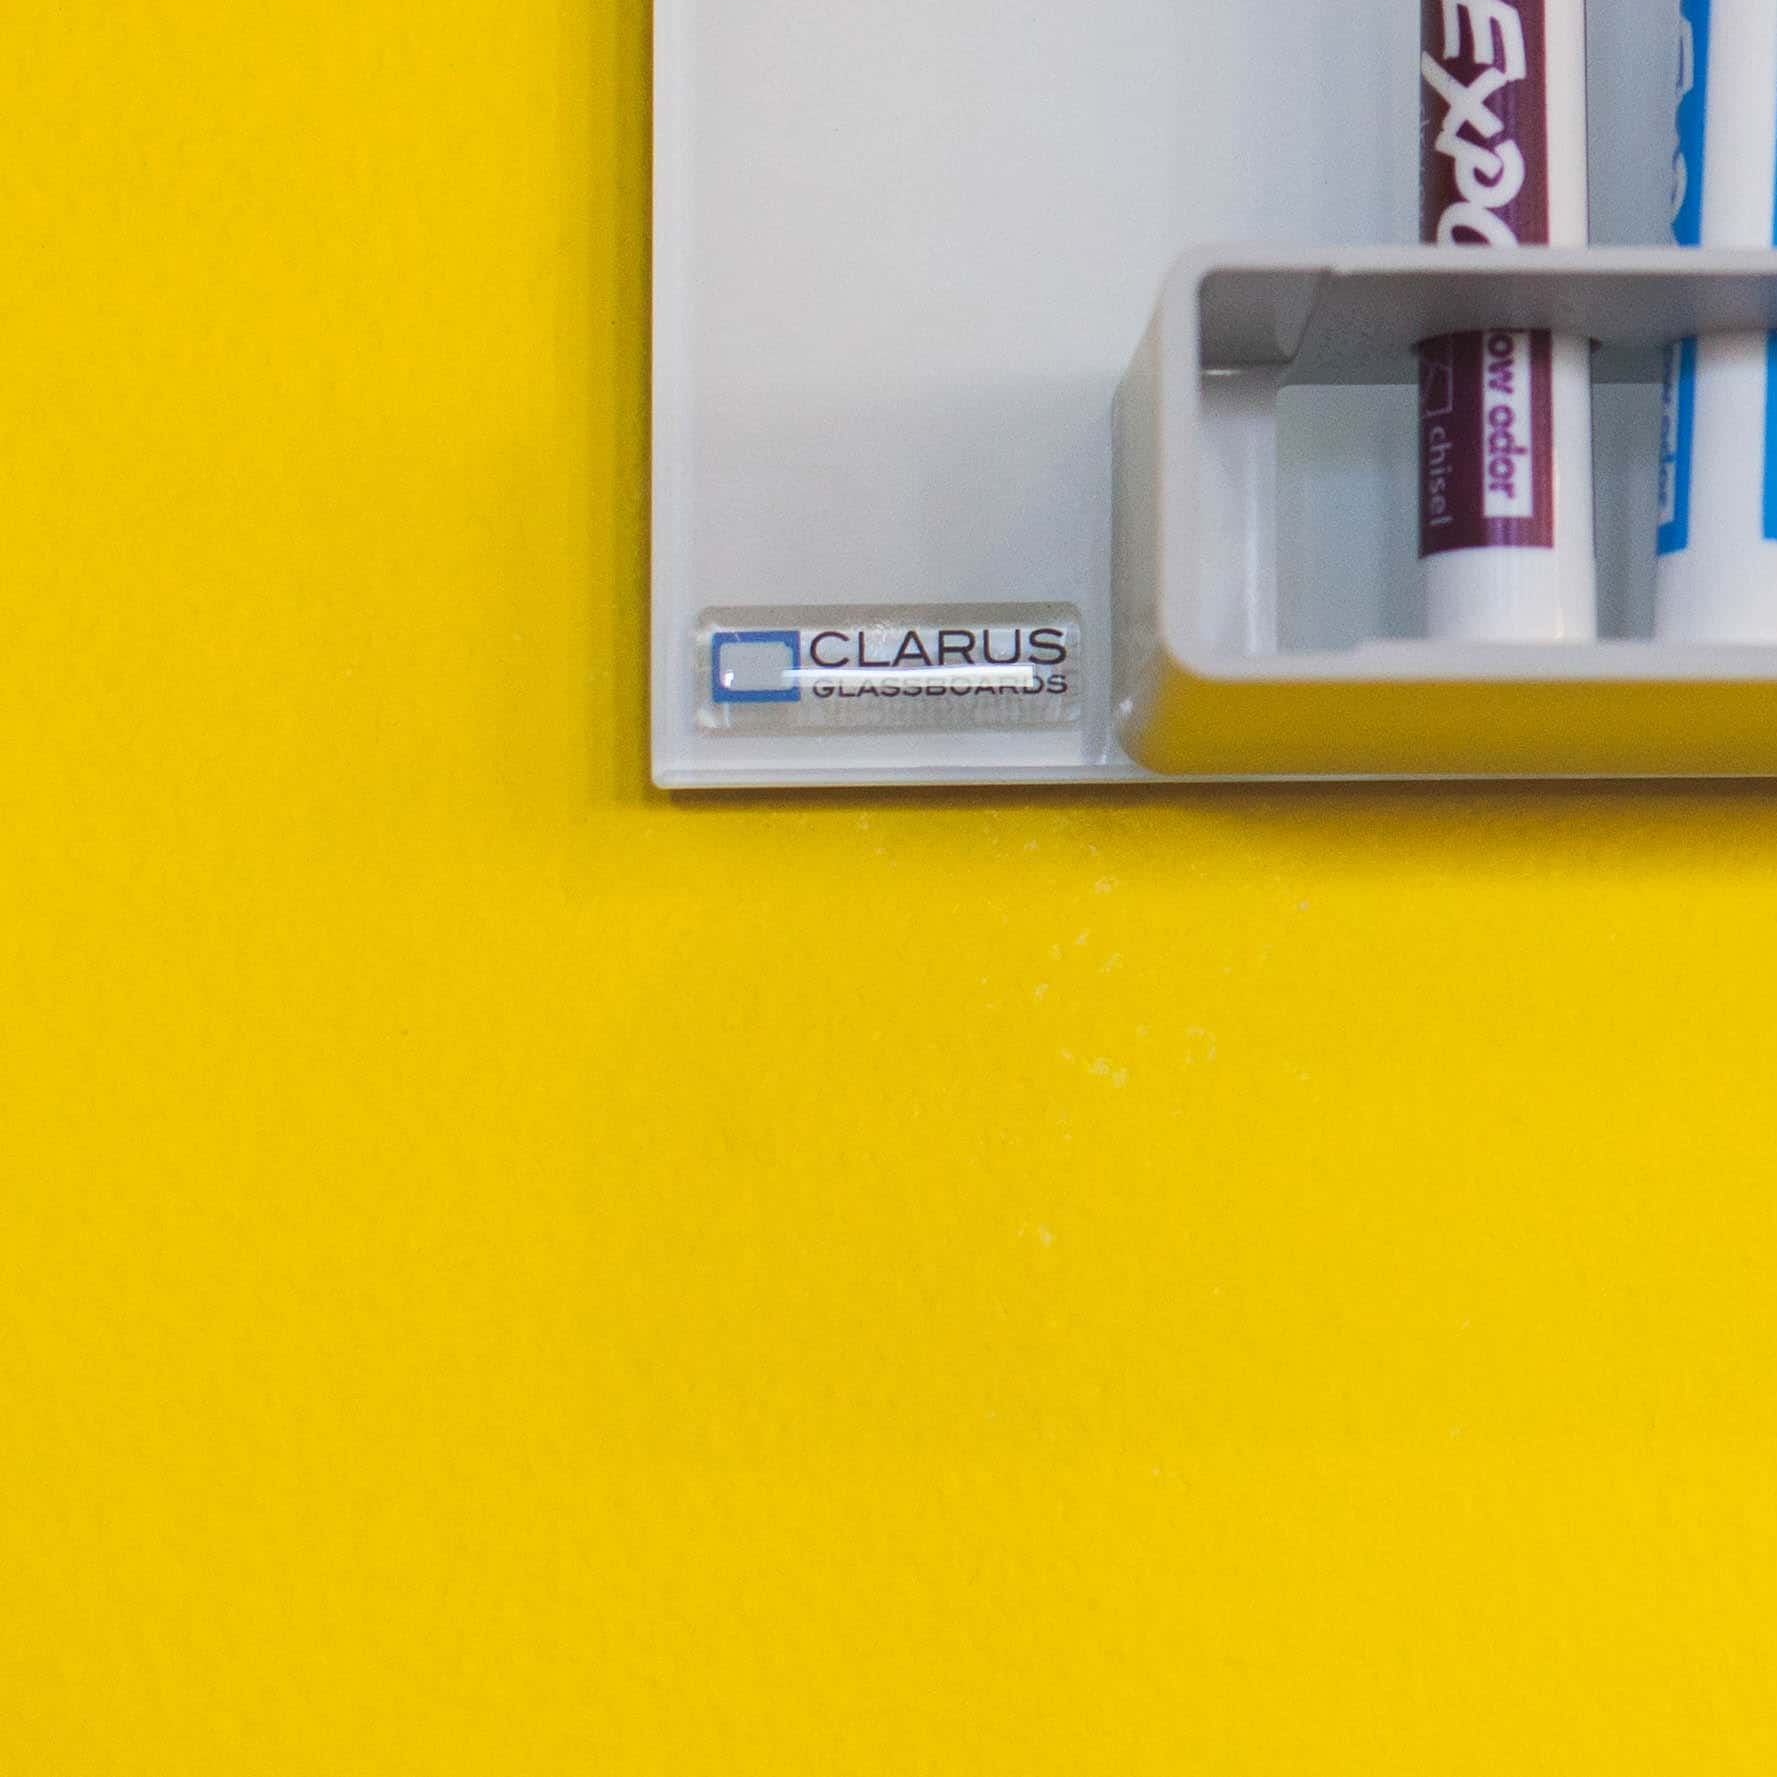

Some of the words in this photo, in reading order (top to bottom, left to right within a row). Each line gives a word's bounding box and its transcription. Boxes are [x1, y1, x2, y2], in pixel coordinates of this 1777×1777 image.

[1429, 426, 1453, 527] chisel
[1488, 405, 1528, 498] odor
[809, 627, 1068, 667] CLARUS
